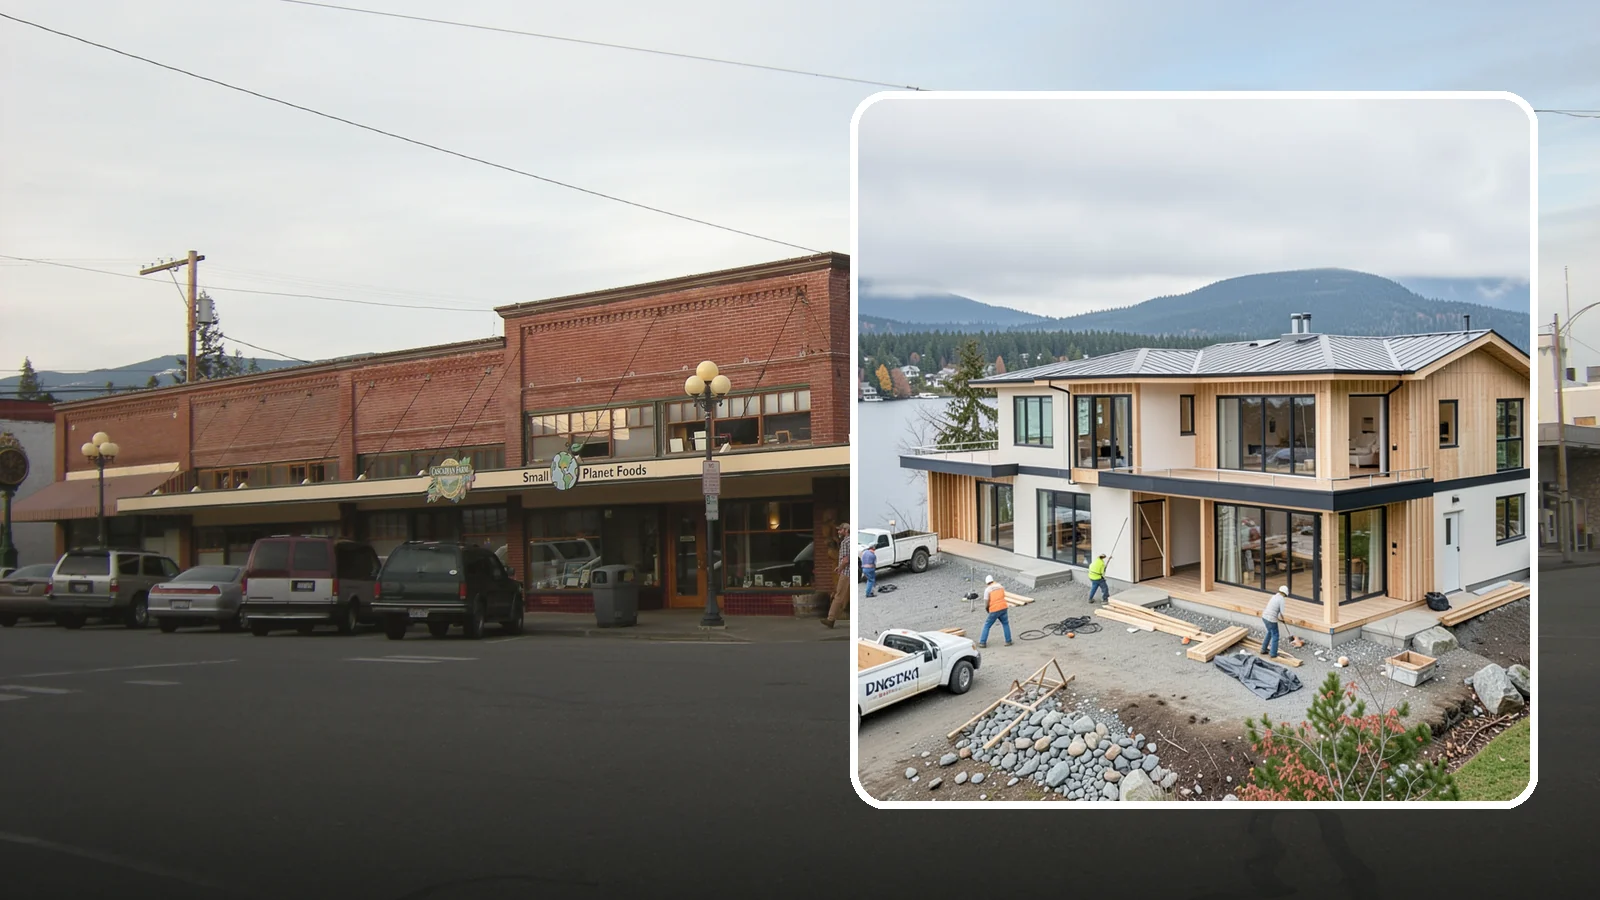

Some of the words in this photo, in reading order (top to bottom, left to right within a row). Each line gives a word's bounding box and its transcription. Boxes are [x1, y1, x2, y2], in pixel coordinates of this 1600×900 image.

[431, 467, 455, 476] CASCADIAN
[456, 466, 469, 474] FARM
[523, 472, 549, 483] Small
[583, 467, 614, 479] Planet
[617, 464, 647, 477] Foods
